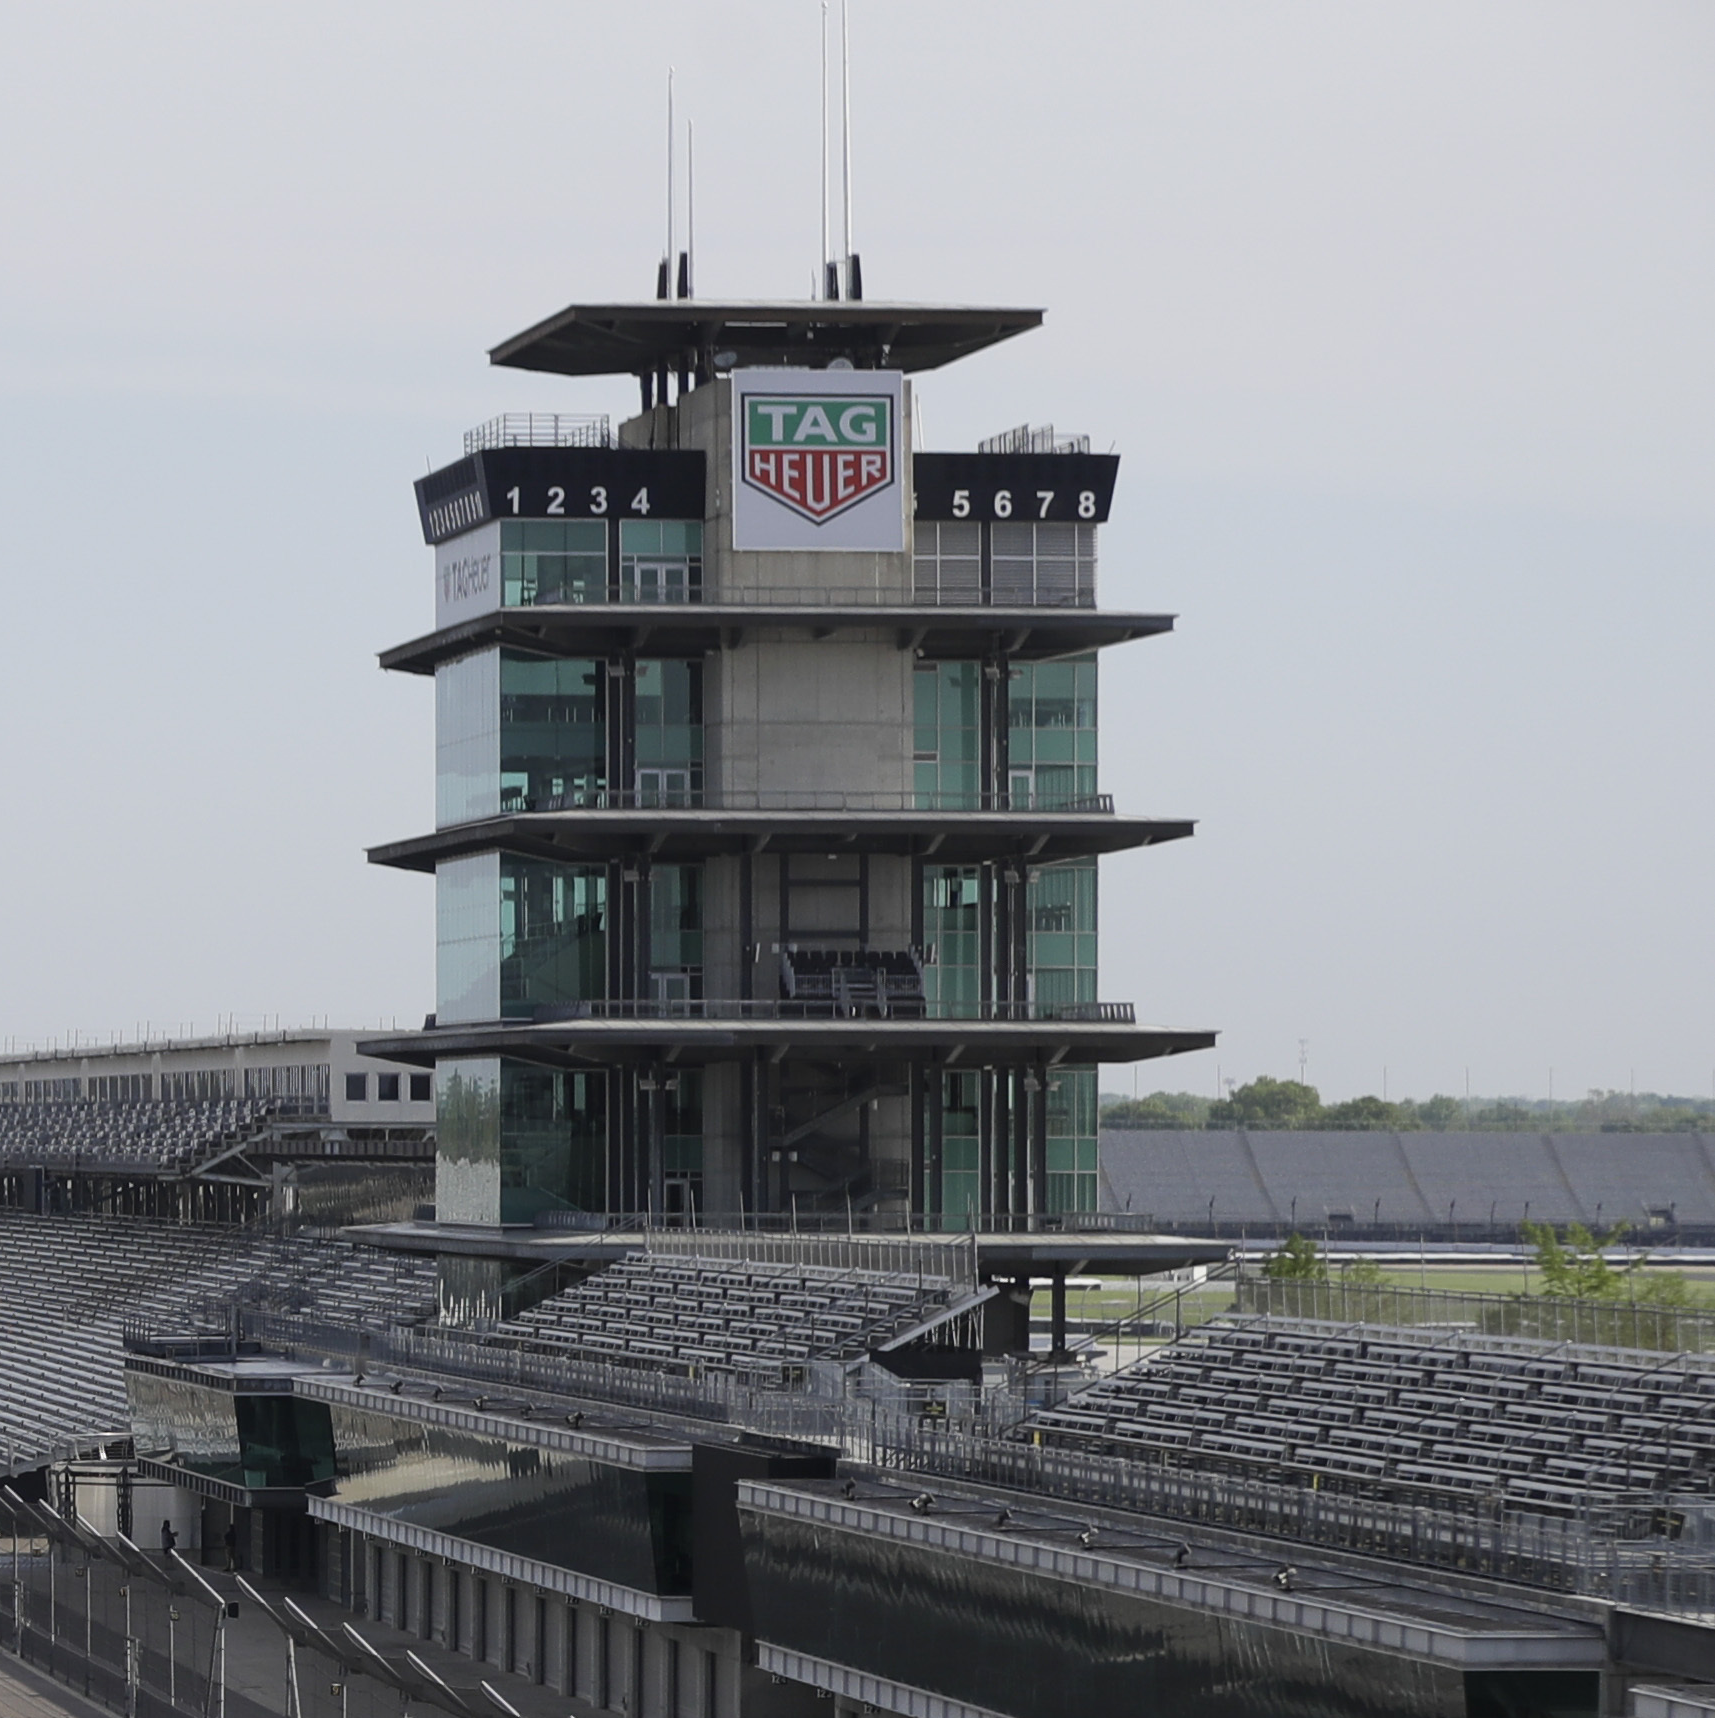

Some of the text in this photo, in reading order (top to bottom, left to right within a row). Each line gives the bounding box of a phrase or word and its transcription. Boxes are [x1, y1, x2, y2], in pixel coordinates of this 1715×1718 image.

[757, 404, 877, 442] TAG
[753, 452, 882, 513] HEUER
[506, 486, 650, 515] 1 2 3 4
[952, 489, 1096, 518] 5 6 7 8
